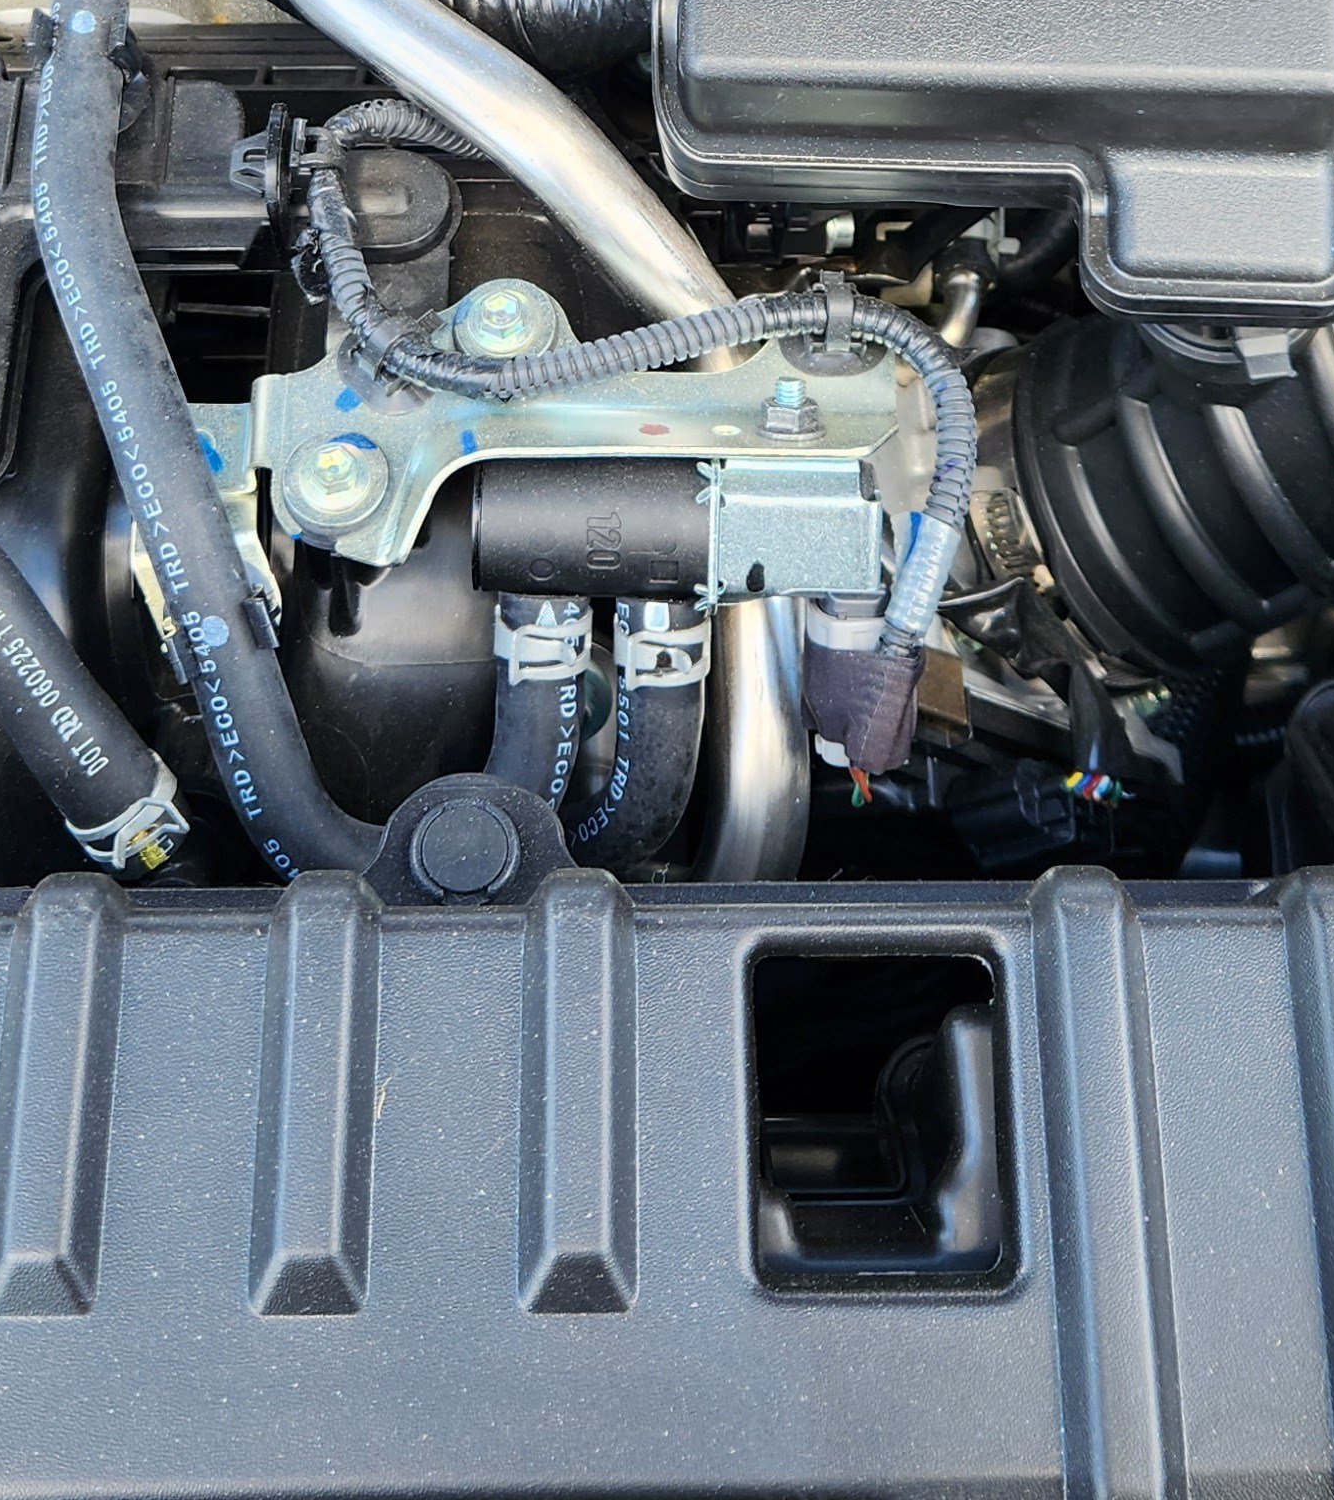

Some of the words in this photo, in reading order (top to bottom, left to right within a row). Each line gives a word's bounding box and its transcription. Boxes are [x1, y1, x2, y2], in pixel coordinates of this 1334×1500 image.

[586, 510, 622, 571] 120
[1, 636, 61, 707] 060225
[71, 736, 110, 778] DOT
